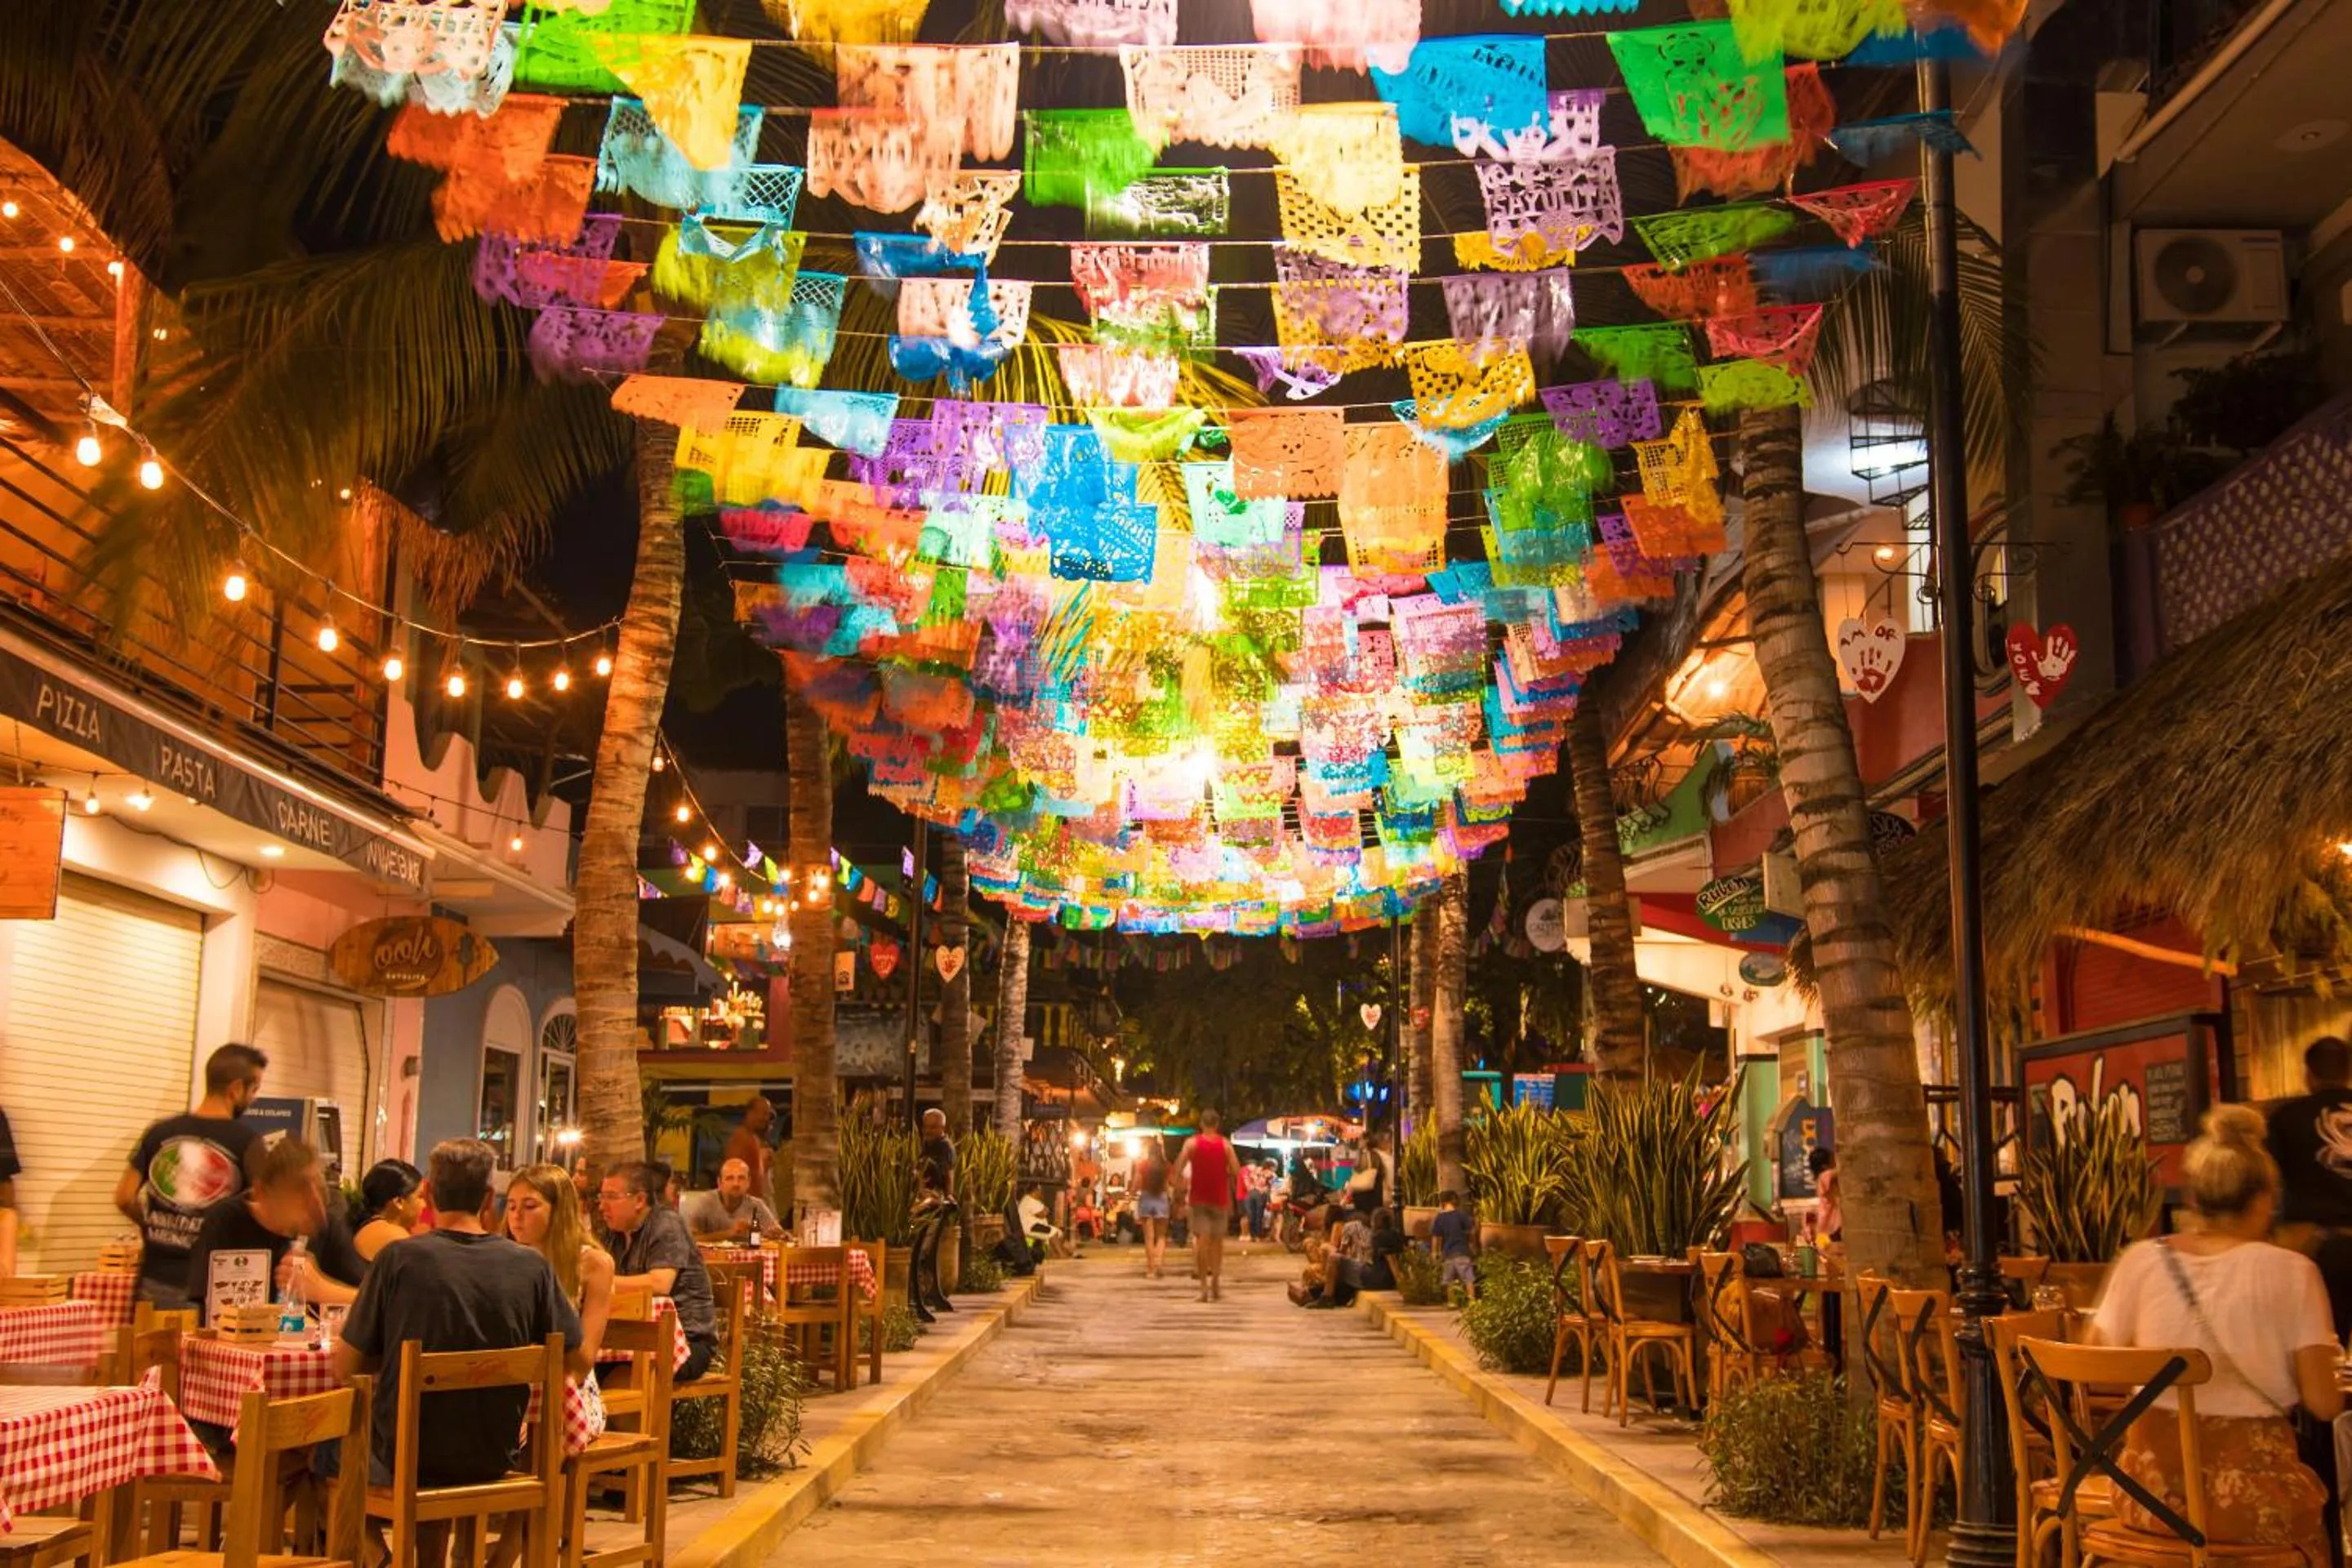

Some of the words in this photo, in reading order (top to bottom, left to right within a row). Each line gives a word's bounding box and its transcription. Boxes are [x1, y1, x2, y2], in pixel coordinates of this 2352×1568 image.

[36, 684, 100, 744] PIZZA
[161, 745, 216, 800] PASTA
[278, 800, 332, 847] CARNE
